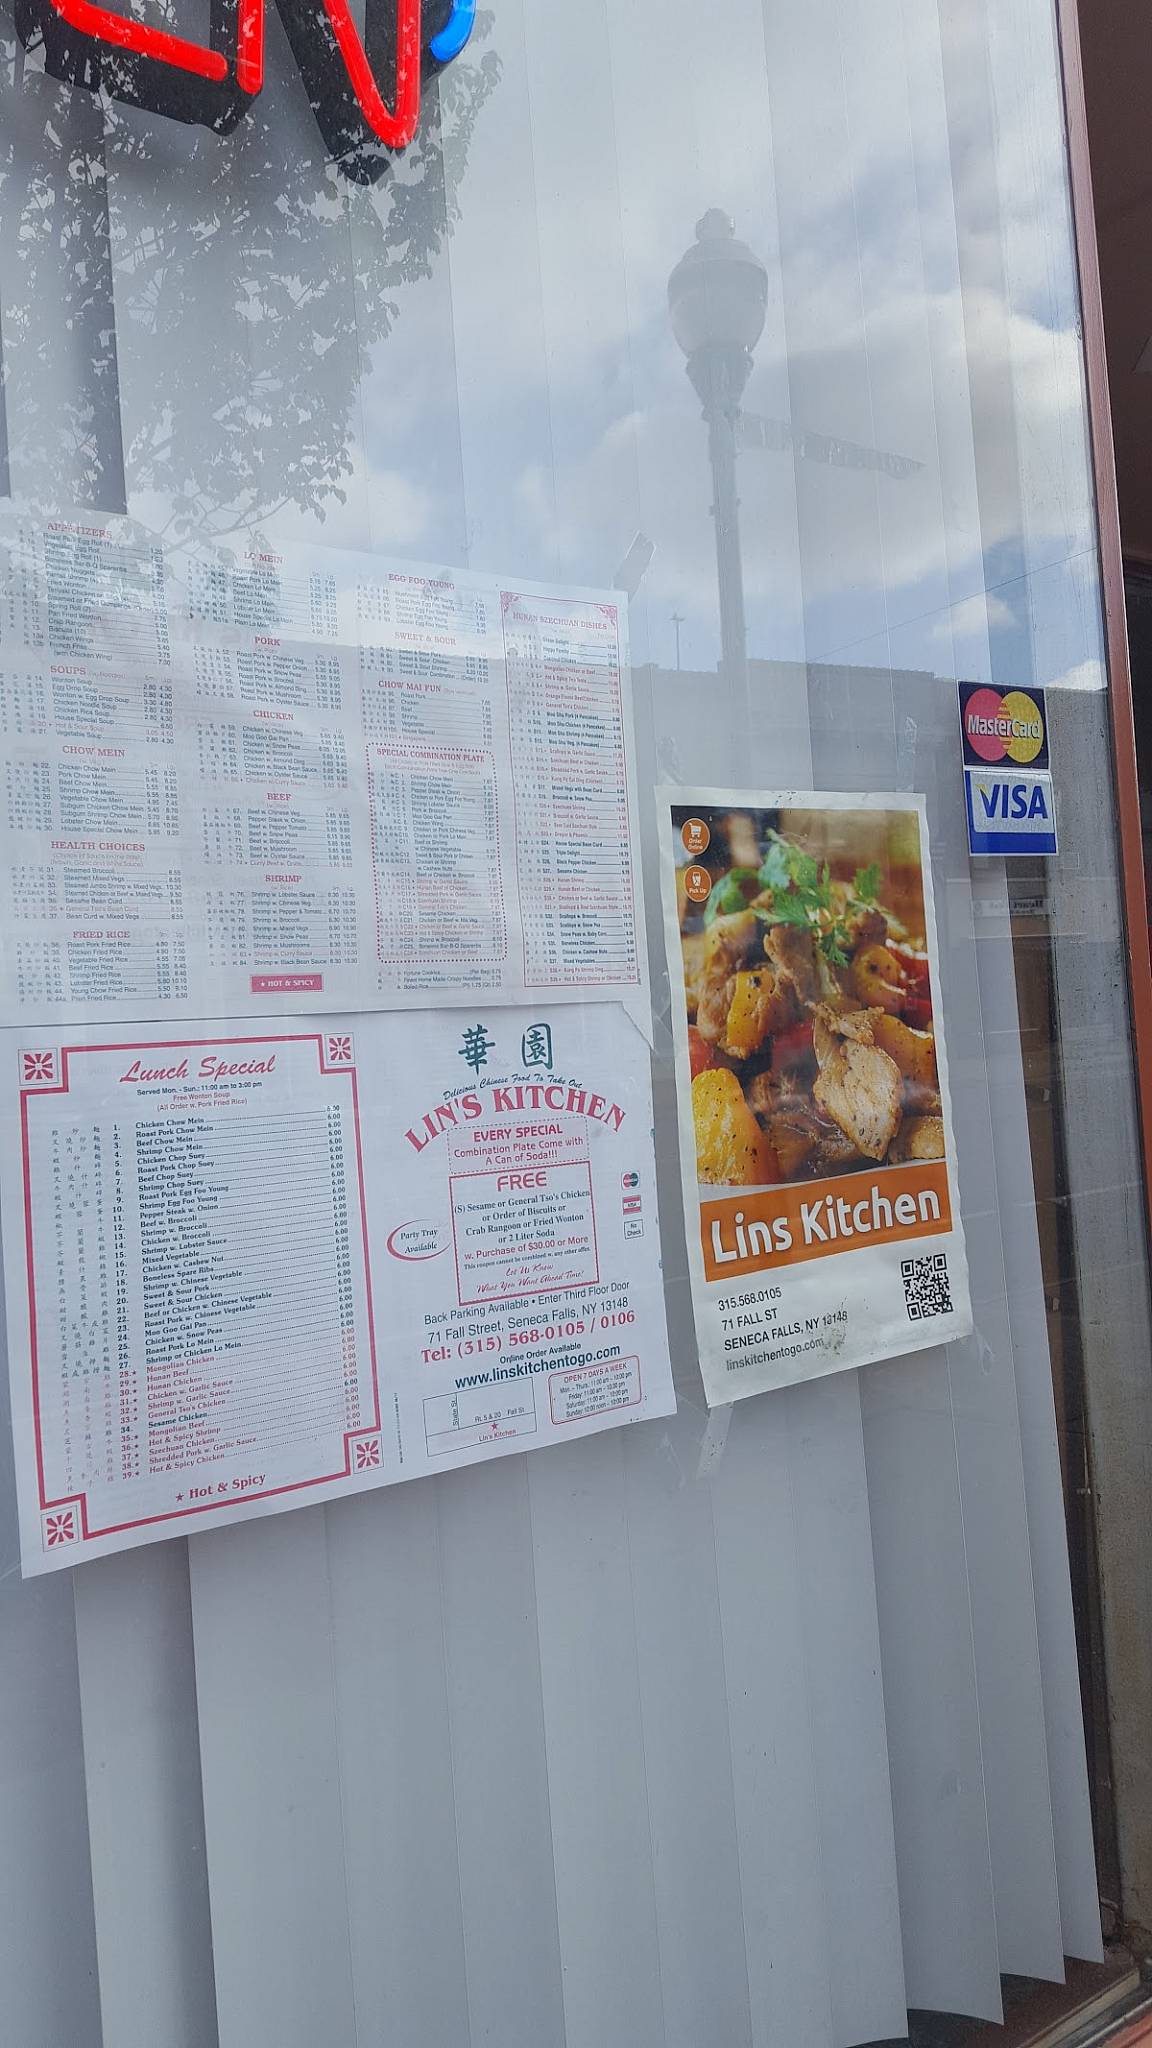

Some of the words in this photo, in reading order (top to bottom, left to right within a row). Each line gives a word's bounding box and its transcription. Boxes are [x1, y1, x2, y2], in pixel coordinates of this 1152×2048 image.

[255, 636, 281, 646] PORK
[50, 665, 86, 675] SOUPS
[378, 680, 404, 689] CHOW
[406, 681, 422, 691] MAI
[424, 683, 441, 693] FUN
[253, 710, 294, 721] CHICKEN
[967, 714, 1041, 739] MasterCard
[62, 745, 95, 755] CHOW
[98, 748, 125, 758] MEIN
[377, 748, 409, 757] SPECIAL
[410, 750, 461, 760] COMBINATION
[463, 755, 485, 763] PLATE
[267, 792, 291, 801] BEEF
[976, 784, 1048, 819] VISA
[51, 841, 95, 850] HEALTH
[99, 842, 146, 852] CHOICES
[265, 875, 302, 883] SHRIMP
[73, 930, 103, 939] FRIED
[106, 930, 131, 939] RICE
[458, 1022, 553, 1075] 華園
[120, 1059, 189, 1083] Lunch
[198, 1054, 276, 1081] Special
[136, 1088, 161, 1096] Served
[162, 1086, 178, 1094] Mon.
[252, 1081, 262, 1089] pm
[443, 1084, 477, 1101] Delicious
[479, 1076, 508, 1089] Chinese
[511, 1073, 531, 1083] Food
[533, 1073, 544, 1082] To
[547, 1074, 566, 1085] Take
[568, 1079, 583, 1089] Out
[135, 1121, 165, 1129] Chicken
[166, 1119, 186, 1127] Chow
[404, 1092, 483, 1153] LIN'S
[492, 1085, 627, 1133] KITCHEN
[473, 1127, 512, 1143] EVERY
[515, 1124, 563, 1138] SPECIAL
[453, 1143, 511, 1158] Combination
[513, 1141, 537, 1153] Plate
[538, 1140, 563, 1150] Come
[565, 1136, 584, 1147] with
[485, 1154, 493, 1166] A
[495, 1153, 513, 1165] Can
[514, 1152, 524, 1163] of
[526, 1150, 558, 1162] Soda!!!
[138, 1175, 155, 1183] Beef
[156, 1172, 176, 1181] Chop
[176, 1171, 194, 1180] Suey
[497, 1171, 547, 1192] FREE
[454, 1204, 466, 1214] (S)
[467, 1201, 496, 1212] Sesame
[497, 1200, 506, 1208] or
[508, 1196, 539, 1207] General
[539, 1193, 560, 1203] Tso's
[560, 1189, 590, 1200] Chicken
[140, 1220, 157, 1228] Beef
[167, 1215, 197, 1225] Broccoli
[482, 1214, 491, 1222] or
[492, 1210, 516, 1221] Order
[517, 1208, 526, 1217] of
[527, 1205, 556, 1216] Biscuits
[558, 1204, 566, 1212] or
[400, 1231, 419, 1241] Party
[420, 1229, 438, 1238] Tray
[465, 1225, 486, 1236] Crab
[487, 1222, 521, 1234] Rangoon
[533, 1216, 554, 1227] Fried
[555, 1213, 584, 1224] Wonton
[710, 1212, 793, 1264] Lins
[800, 1185, 941, 1245] Kitchen
[498, 1236, 507, 1244] or
[508, 1234, 514, 1242] 2
[515, 1232, 534, 1241] Liter
[535, 1229, 555, 1239] Soda
[404, 1241, 437, 1254] Available
[464, 1252, 474, 1260] w.
[476, 1246, 516, 1259] Purchase
[517, 1243, 526, 1252] of
[528, 1239, 555, 1251] $30.00
[557, 1240, 566, 1248] or
[567, 1235, 589, 1246] More
[424, 1312, 448, 1326] Back
[450, 1307, 485, 1321] Parking
[488, 1298, 529, 1314] Available
[538, 1294, 562, 1306] Enter
[563, 1289, 586, 1302] Third
[588, 1285, 610, 1298] Floor
[611, 1280, 630, 1293] Door
[718, 1286, 782, 1312] 315.568.0105
[428, 1332, 442, 1345] 71
[445, 1327, 465, 1341] Fall
[468, 1321, 504, 1337] Street,
[507, 1314, 549, 1330] Seneca
[551, 1309, 579, 1323] Falls,
[582, 1303, 598, 1318] NY
[600, 1296, 629, 1313] 13148
[721, 1319, 734, 1332] 71
[737, 1312, 764, 1328] FALL
[764, 1308, 778, 1322] ST
[421, 1346, 452, 1364] Tel:
[457, 1336, 502, 1359] (315)
[509, 1319, 585, 1347] 568-0105
[590, 1317, 596, 1333] /
[600, 1310, 636, 1330] 0106
[724, 1331, 770, 1352] SENECA
[771, 1323, 804, 1341] FALLS,
[806, 1317, 819, 1331] NY
[822, 1310, 848, 1328] 13148
[499, 1353, 524, 1365] Online
[526, 1348, 547, 1360] Order
[549, 1341, 582, 1355] Available
[726, 1337, 824, 1372] linskitchentogo.com
[454, 1343, 621, 1389] www.linskitchentogo.com
[563, 1375, 582, 1384] OPEN
[583, 1372, 587, 1380] 7
[588, 1368, 604, 1379] DAYS
[610, 1362, 627, 1372] WEEK
[148, 1418, 177, 1428] Sesame
[178, 1412, 208, 1423] Chicken
[189, 1488, 213, 1500] Hot
[217, 1482, 228, 1492] &
[232, 1473, 266, 1490] Spicy
